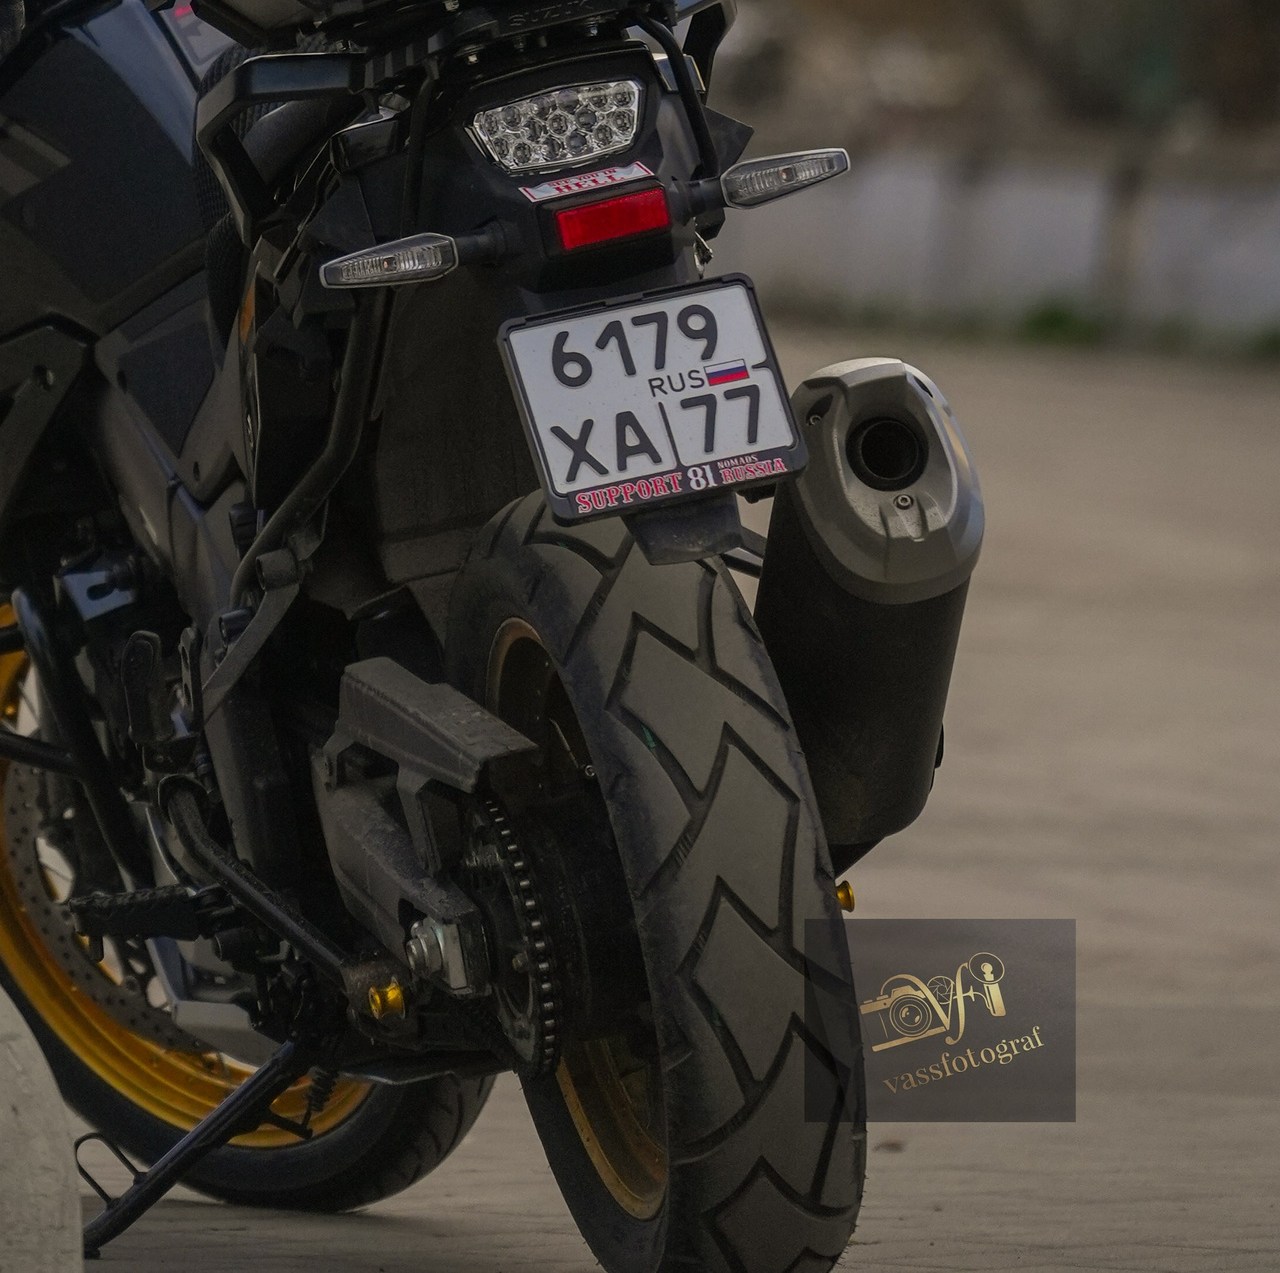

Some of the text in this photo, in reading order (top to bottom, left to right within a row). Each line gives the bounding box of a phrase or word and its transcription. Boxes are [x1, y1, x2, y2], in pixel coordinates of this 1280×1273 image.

[551, 303, 718, 388] 6179
[648, 369, 705, 397] RUS
[680, 384, 760, 453] 77
[575, 457, 788, 514] SUPPORT 81 RUSSIA
[717, 454, 758, 470] NOMADS
